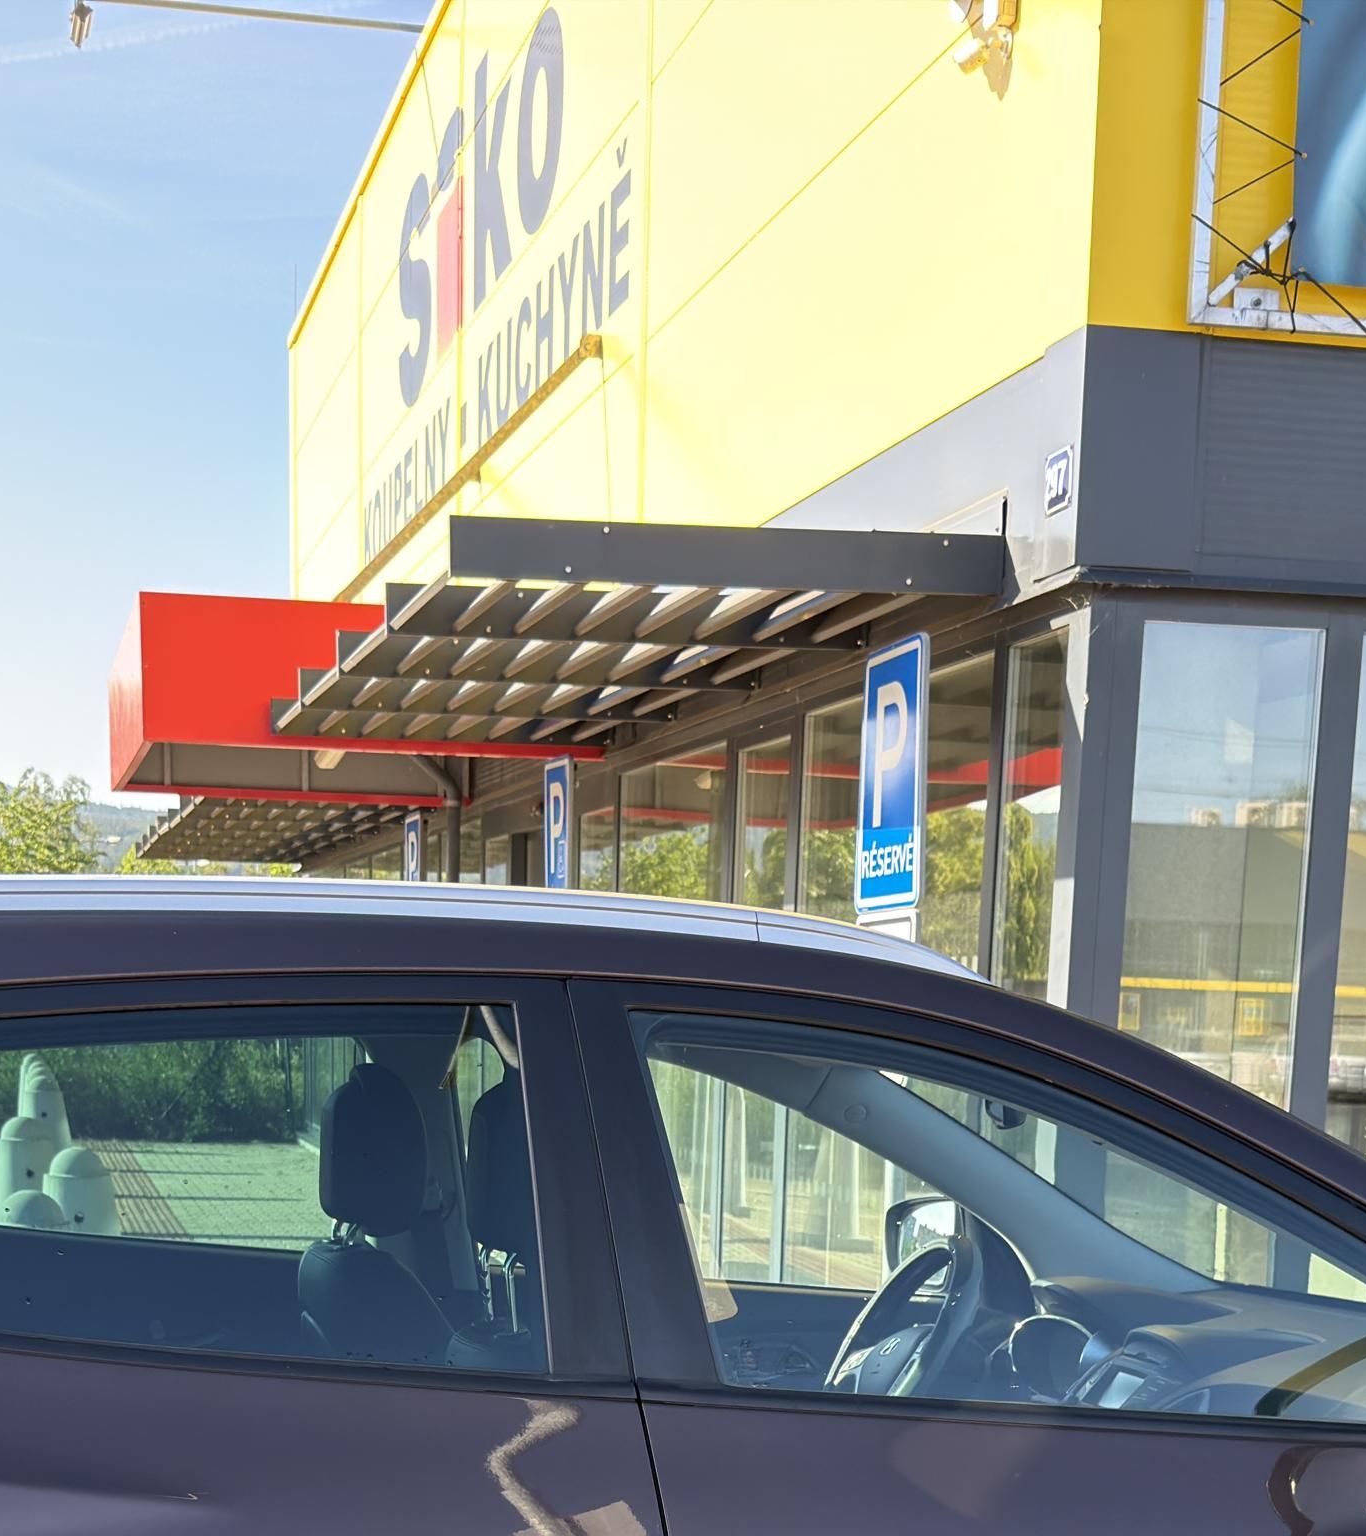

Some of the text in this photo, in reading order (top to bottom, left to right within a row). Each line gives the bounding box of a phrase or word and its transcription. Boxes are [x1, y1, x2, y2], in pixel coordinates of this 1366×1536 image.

[364, 136, 632, 565] KOUPELNY KUCHYNĚ
[872, 681, 908, 828] P
[408, 831, 417, 881] P
[550, 782, 564, 874] P
[861, 833, 913, 879] RÉSERVÉ
